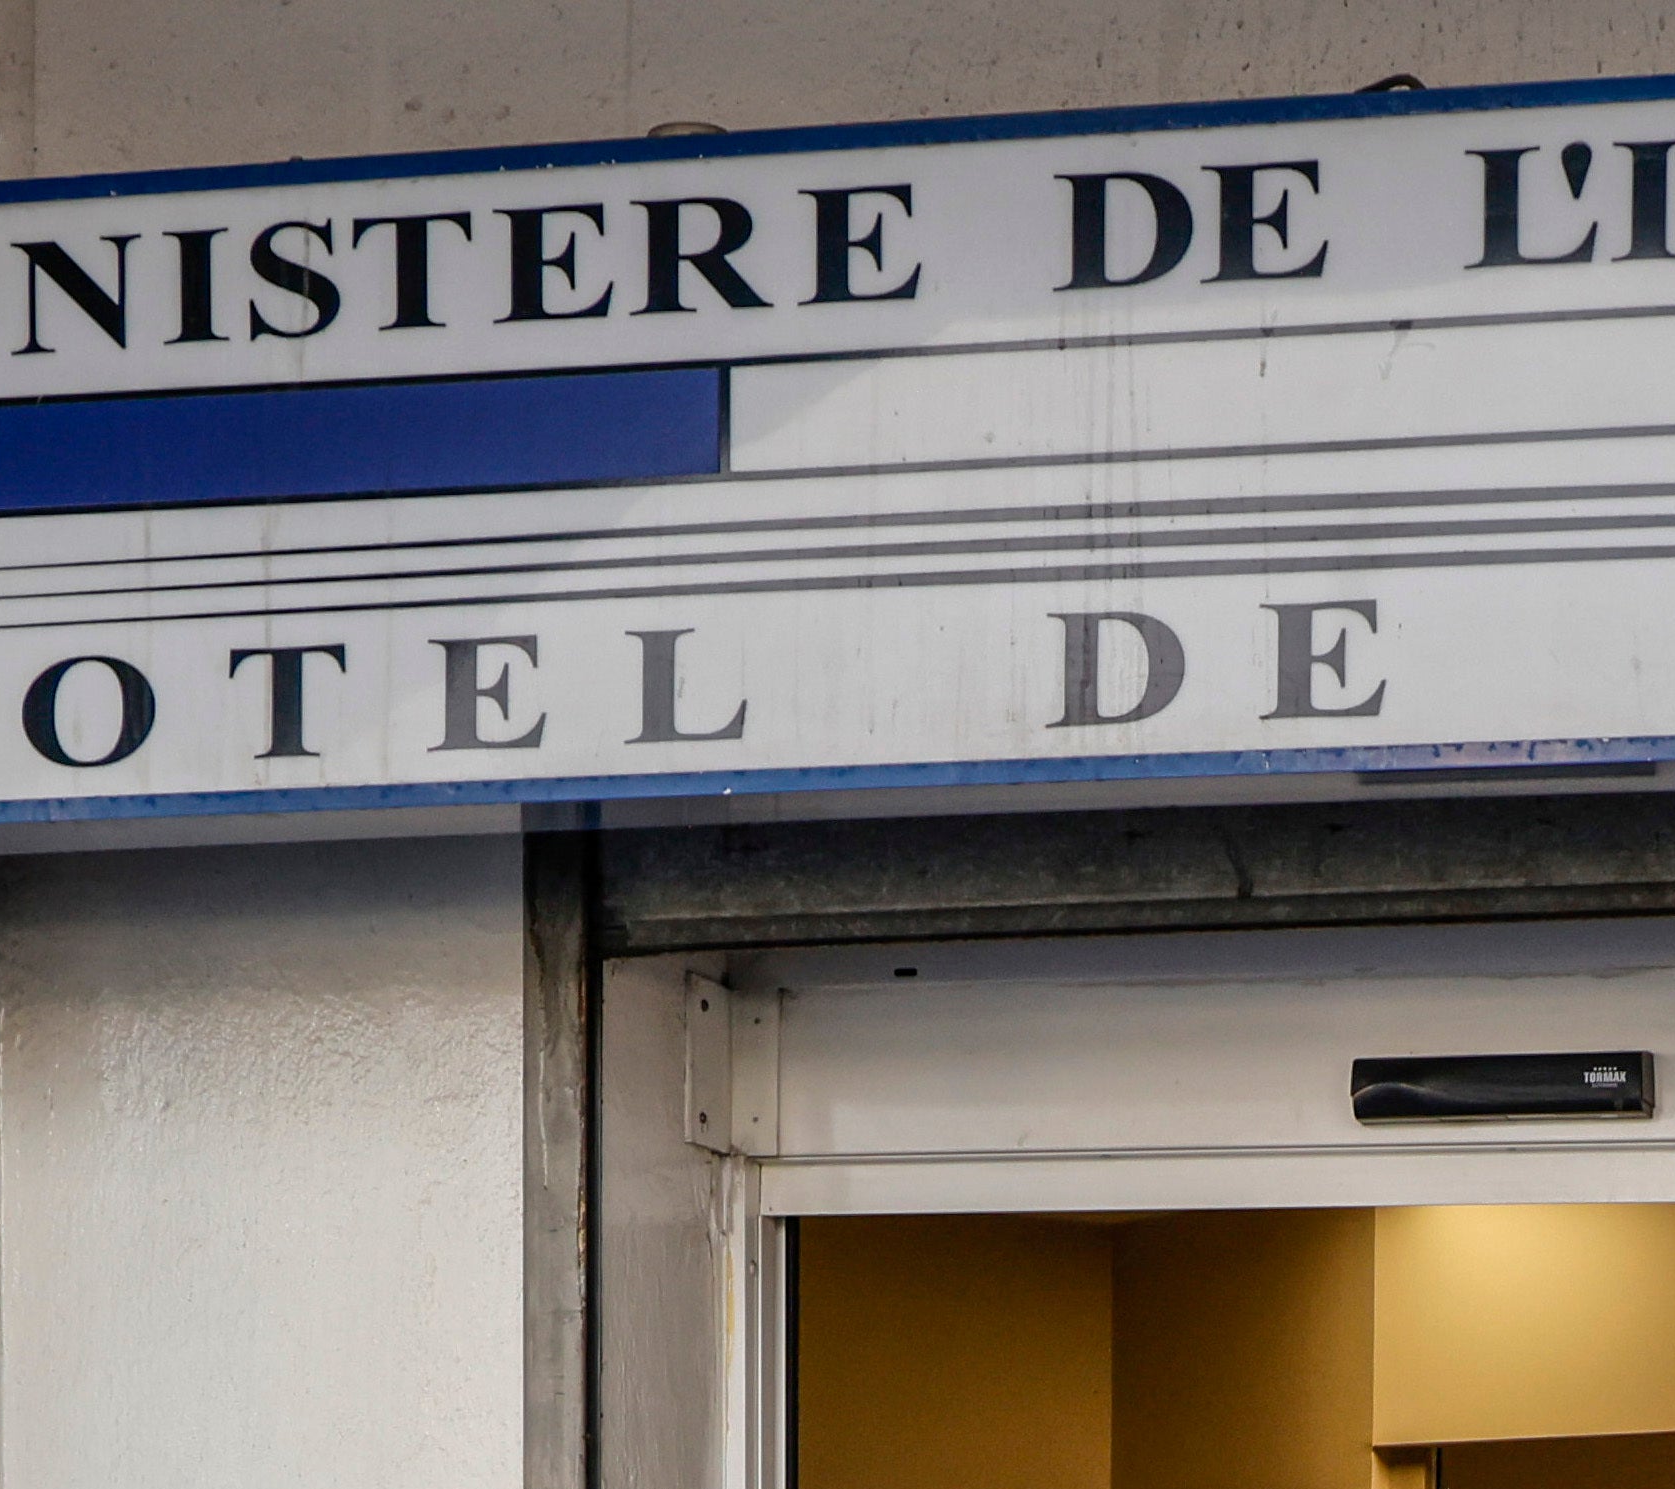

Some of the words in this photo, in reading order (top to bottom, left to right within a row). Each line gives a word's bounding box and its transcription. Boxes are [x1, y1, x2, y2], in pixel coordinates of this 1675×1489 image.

[1053, 159, 1329, 292] DE
[1044, 598, 1387, 729] DE
[1583, 1071, 1627, 1083] TORMAX
